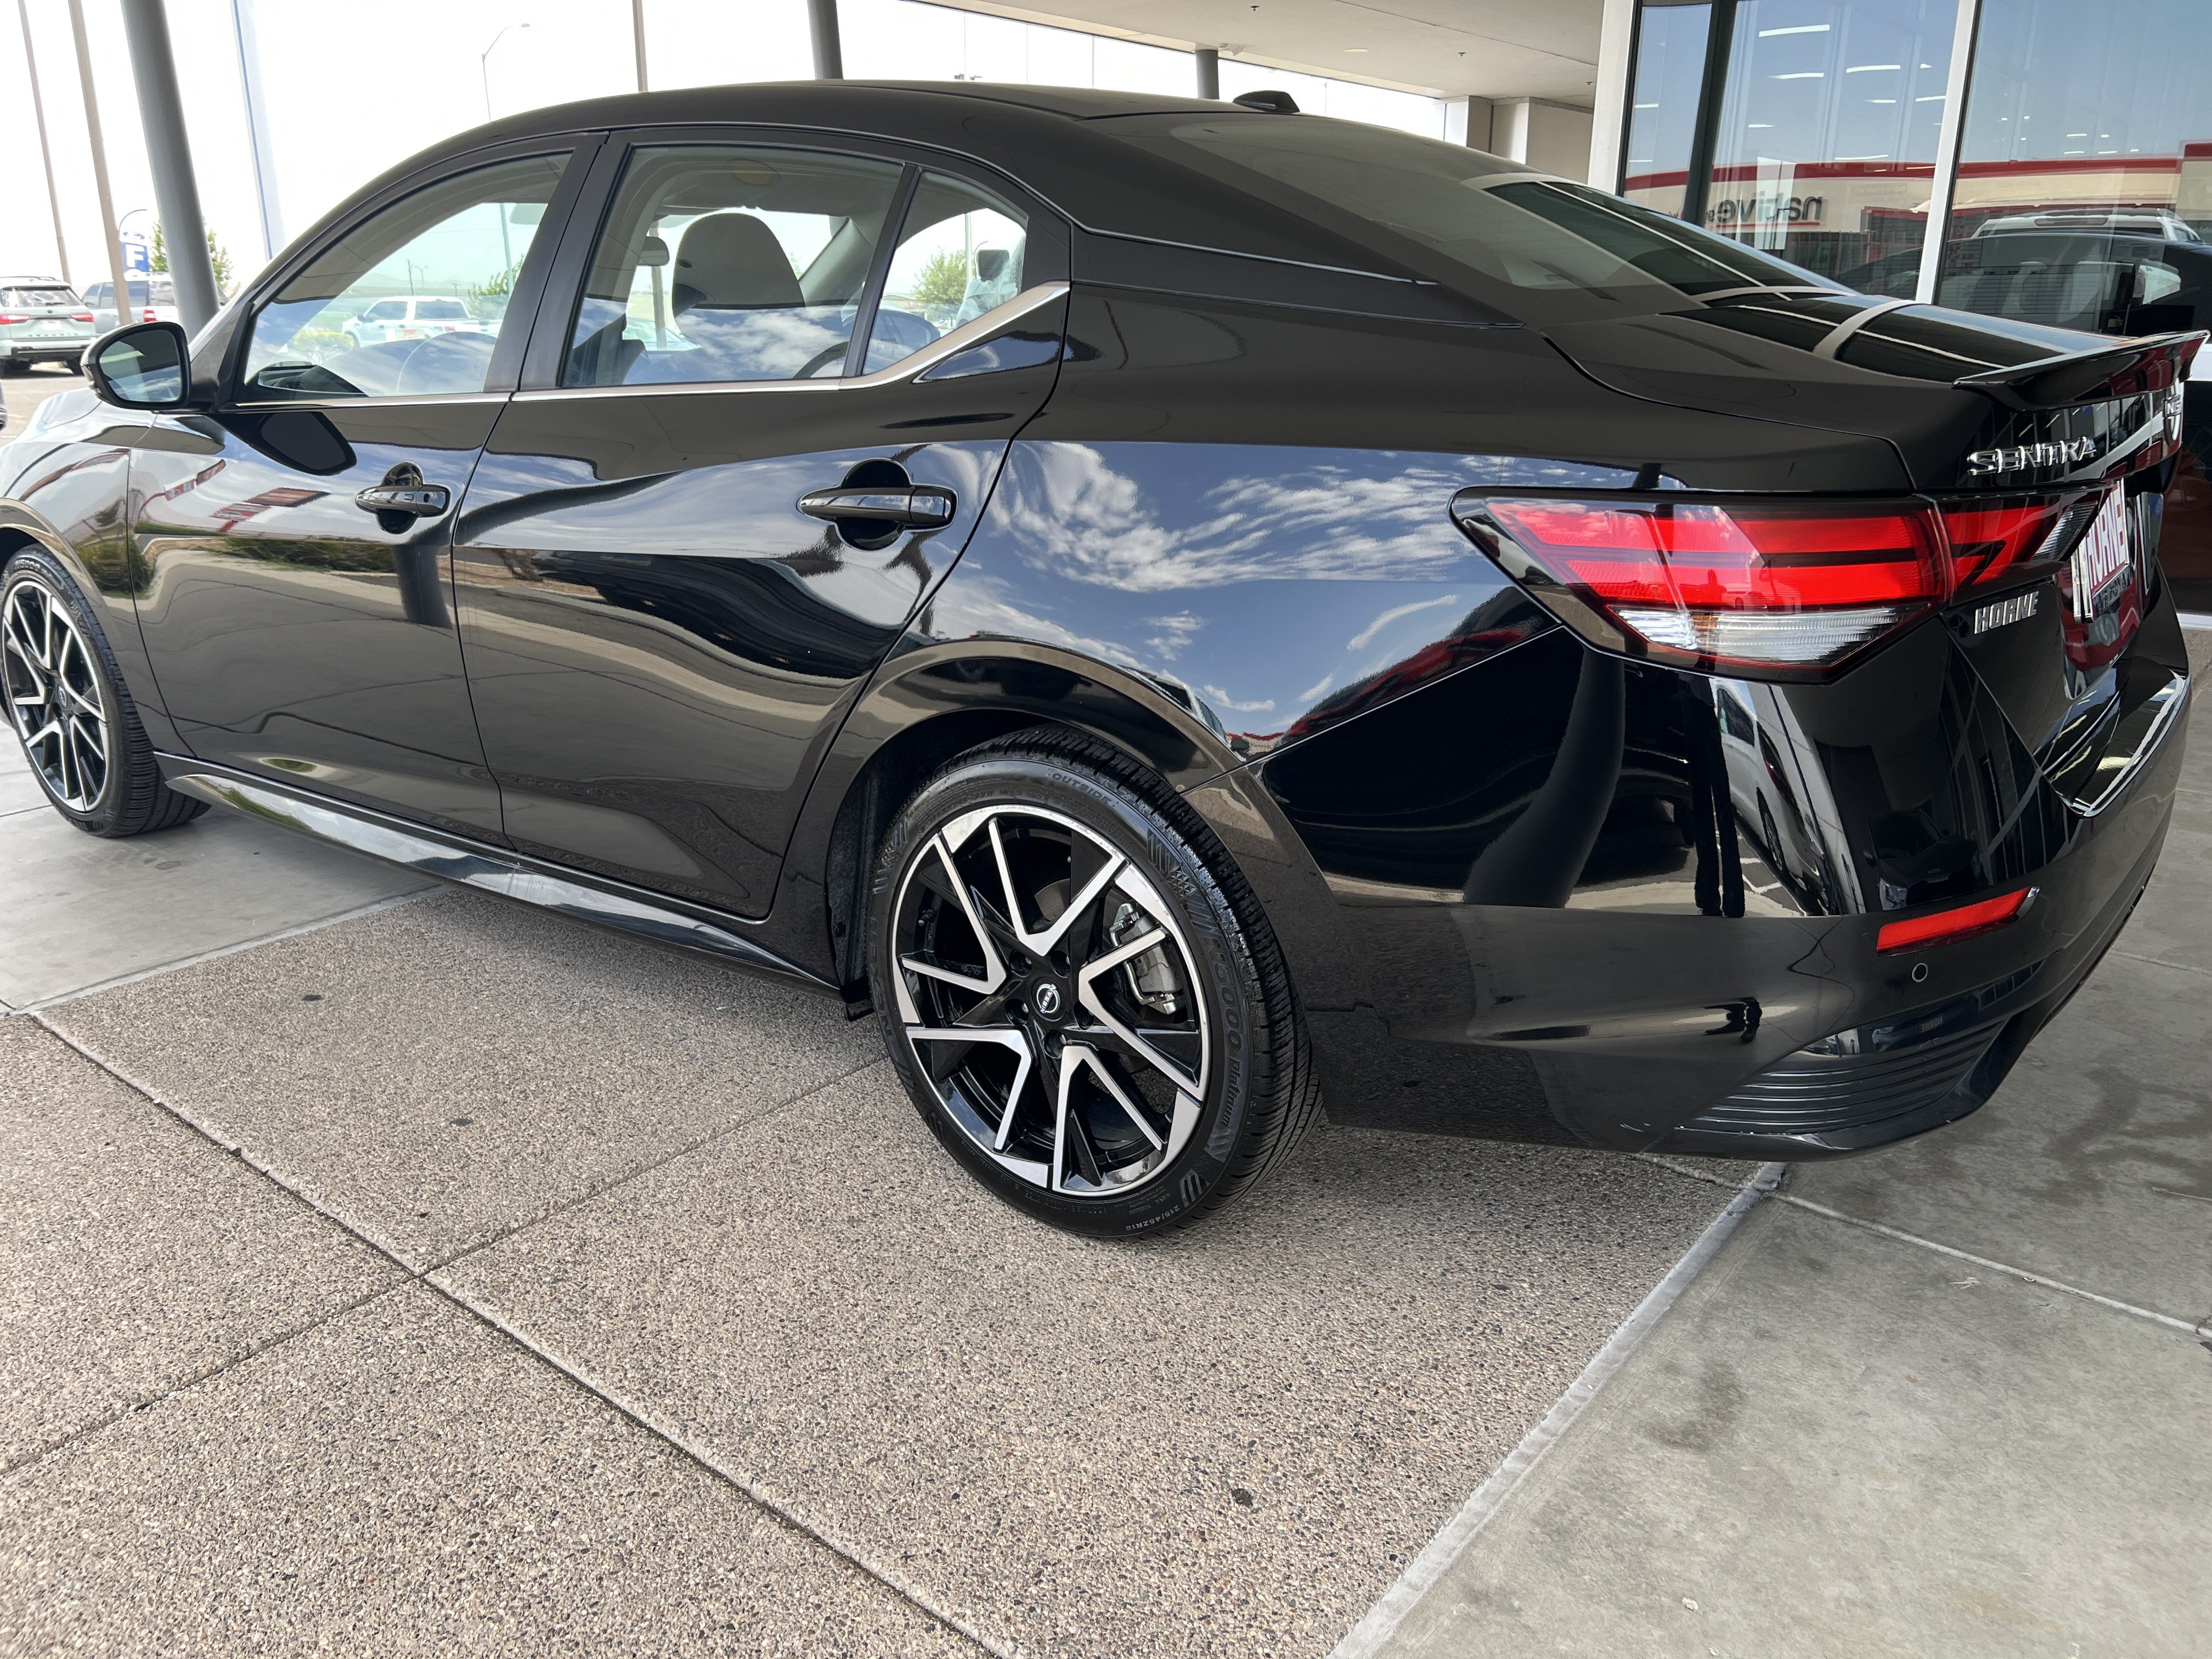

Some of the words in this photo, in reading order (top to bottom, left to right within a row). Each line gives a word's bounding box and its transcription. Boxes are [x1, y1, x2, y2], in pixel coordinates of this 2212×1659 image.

[1967, 437, 2097, 476] SENTRA
[2085, 488, 2126, 590] HORNE
[1974, 591, 2039, 634] HORNE
[1052, 772, 1112, 805] OUTSIDE
[869, 916, 893, 1036] NEXEN
[1040, 983, 1057, 1014] NISSAN
[1203, 935, 1242, 1051] N5000
[1222, 1057, 1241, 1127] Platinum
